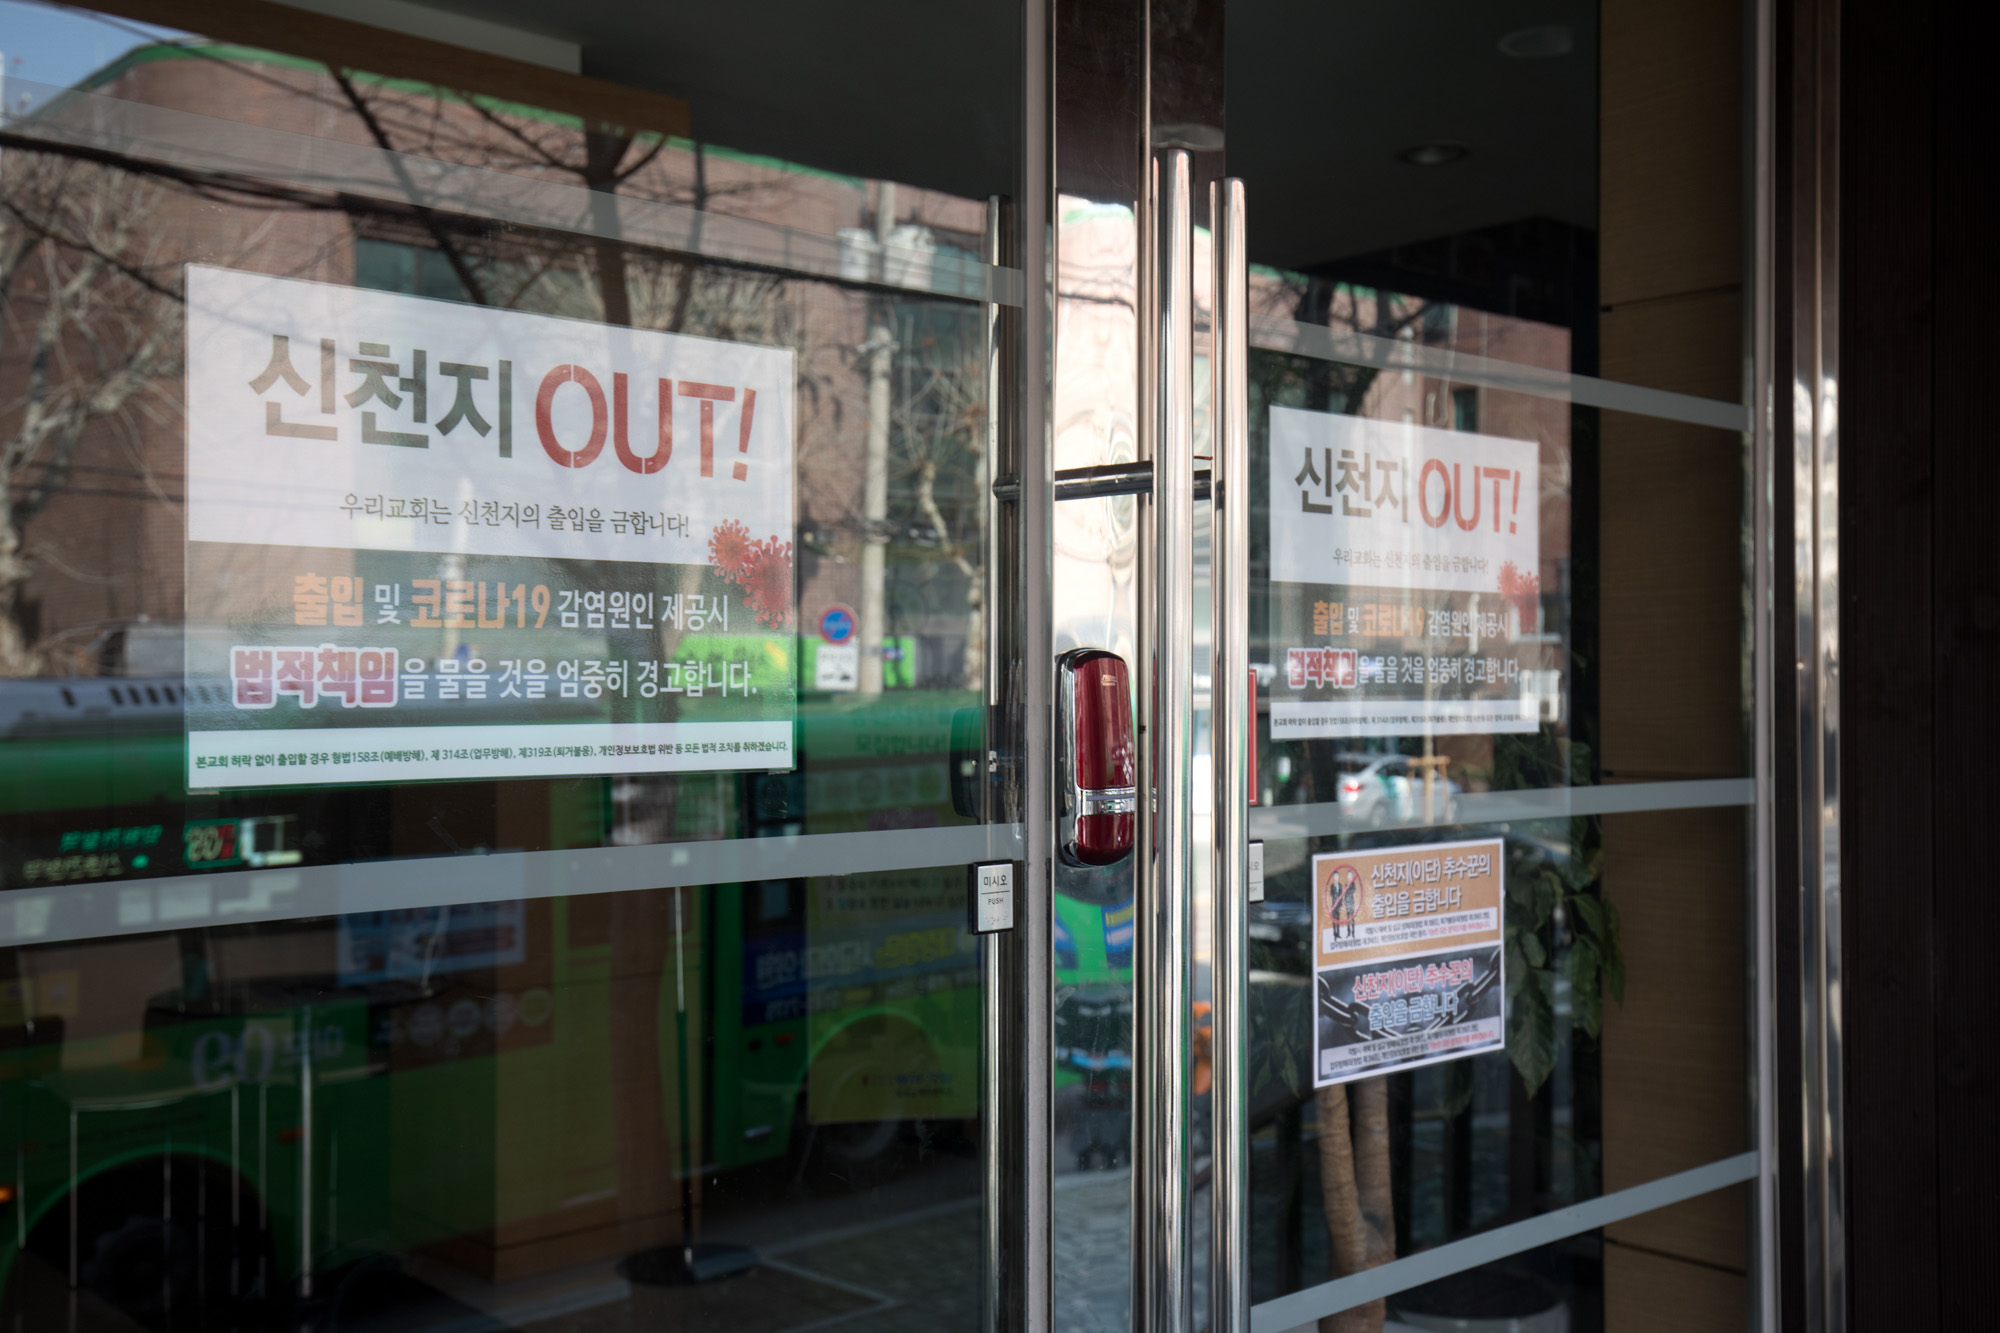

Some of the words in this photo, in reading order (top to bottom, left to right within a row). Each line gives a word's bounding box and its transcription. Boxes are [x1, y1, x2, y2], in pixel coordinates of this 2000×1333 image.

[248, 334, 513, 458] 신천지
[535, 363, 757, 482] OUT!
[1294, 446, 1409, 524] 신천지
[1418, 458, 1521, 535] OUT!
[339, 491, 453, 525] 우리교회는
[458, 498, 541, 529] 신천지의
[546, 504, 606, 534] 출입을
[611, 509, 690, 539] 금합니다!
[1332, 547, 1382, 569] 우리교회는
[1422, 553, 1451, 572] 출입을
[1452, 555, 1489, 575] 금합니다!
[293, 572, 364, 627] 출입
[374, 583, 401, 626] 및
[409, 578, 551, 631] 코로나19
[557, 587, 654, 631] 감염원인
[661, 592, 730, 633] 제공시
[1313, 600, 1344, 636] 출입
[1348, 606, 1360, 635] 및
[1361, 601, 1425, 637] 코로나19
[1428, 608, 1475, 638] 감염원인
[1475, 611, 1510, 639] 제공시
[434, 658, 491, 700] 물을
[497, 657, 550, 699] 것을
[557, 657, 630, 700] 엄중히
[635, 657, 758, 699] 경고합니다.
[1374, 655, 1398, 684] 물을
[1401, 655, 1424, 684] 것을
[1428, 655, 1462, 684] 엄중히
[195, 754, 229, 769] 본교회
[231, 754, 252, 768] 허락
[255, 753, 275, 767] 없이
[277, 752, 308, 766] 출입할
[310, 751, 330, 765] 경우
[431, 748, 440, 761] 제
[598, 743, 656, 757] 개인정보보호법
[658, 743, 673, 755] 위반
[675, 743, 684, 754] 등
[685, 742, 700, 754] 모든
[702, 742, 717, 753] 법적
[718, 742, 741, 753] 조치를
[742, 740, 789, 753] 취하겠습니다.
[984, 875, 1007, 887] 미시오
[1370, 856, 1442, 889] 신천지(이단)
[1443, 853, 1491, 881] 추수꾼의
[1371, 890, 1411, 920] 출입을
[1413, 884, 1461, 914] 금합니다
[1352, 964, 1424, 1001] 신천지(이단)
[1425, 957, 1474, 989] 추수꾼의
[1368, 997, 1408, 1031] 출입을
[1409, 990, 1459, 1024] 금합니다
